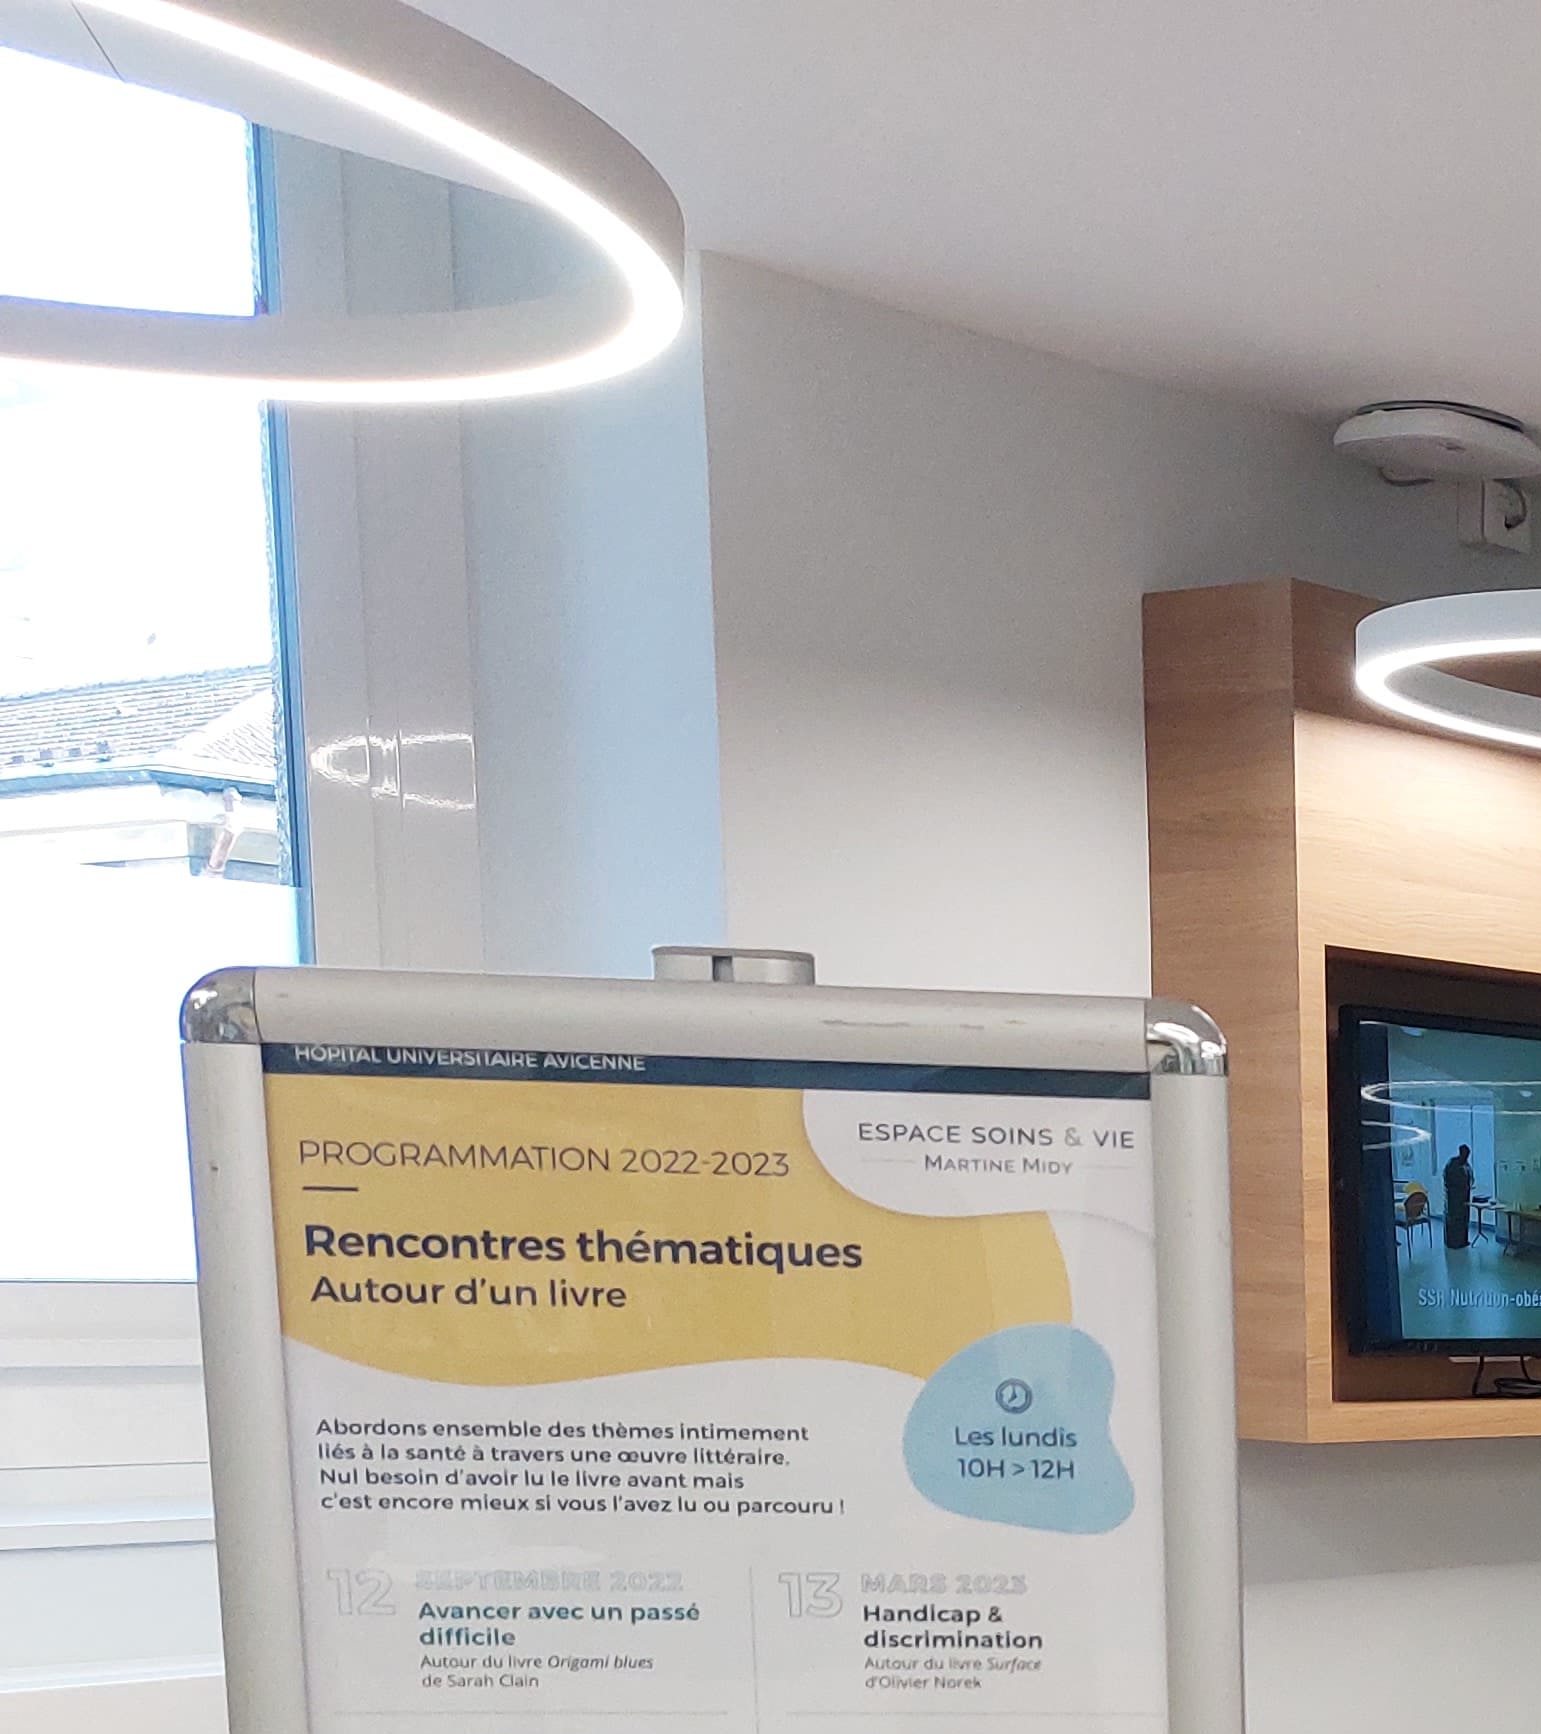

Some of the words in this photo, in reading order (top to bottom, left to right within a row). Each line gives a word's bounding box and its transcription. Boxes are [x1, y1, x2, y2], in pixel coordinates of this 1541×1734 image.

[544, 1052, 646, 1071] AVICENNE
[858, 1122, 960, 1143] ESPACE
[971, 1126, 1053, 1146] SOINS
[1064, 1127, 1083, 1147] &
[1093, 1130, 1134, 1149] VIE
[299, 1139, 611, 1171] PROGRAMMATION
[621, 1148, 790, 1178] 2022-2023
[304, 1224, 566, 1262] Rencontres
[576, 1228, 863, 1275] thématiques
[310, 1275, 445, 1304] Autour
[454, 1278, 537, 1307] d'un
[550, 1279, 627, 1308] livre
[315, 1418, 427, 1437] Abordons
[432, 1420, 542, 1438] ensemble
[547, 1422, 586, 1438] des
[592, 1422, 674, 1440] thèmes
[680, 1423, 810, 1442] intimement
[954, 1426, 995, 1447] Les
[1001, 1426, 1078, 1448] lundis
[318, 1442, 356, 1460] liés
[361, 1443, 375, 1461] à
[381, 1443, 399, 1460] la
[405, 1444, 466, 1462] santé
[472, 1445, 485, 1462] à
[491, 1446, 565, 1463] travers
[571, 1451, 612, 1464] une
[617, 1450, 688, 1465] œuvre
[693, 1447, 791, 1466] littéraire.
[320, 1468, 358, 1486] Nul
[365, 1468, 438, 1486] besoin
[445, 1469, 519, 1487] d'avoir
[525, 1470, 545, 1487] lu
[551, 1470, 570, 1487] le
[575, 1470, 622, 1488] livre
[627, 1474, 688, 1490] avant
[693, 1473, 745, 1490] mais
[957, 1457, 1005, 1479] 10H
[1030, 1458, 1075, 1480] 12H
[321, 1493, 373, 1510] c'est
[378, 1496, 455, 1511] encore
[460, 1494, 530, 1512] mieux
[535, 1494, 552, 1512] si
[557, 1498, 607, 1513] vous
[613, 1496, 673, 1513] l'avez
[677, 1496, 698, 1513] lu
[703, 1499, 731, 1514] ou
[737, 1499, 834, 1518] parcouru
[327, 1567, 397, 1617] 12
[778, 1571, 844, 1618] 13
[860, 1573, 948, 1595] MARS
[418, 1601, 521, 1621] Avancer
[527, 1603, 584, 1621] avec
[590, 1603, 623, 1621] un
[630, 1600, 700, 1625] passé
[863, 1605, 981, 1627] Handicap
[988, 1605, 1004, 1623] &
[418, 1626, 517, 1646] difficile
[863, 1629, 1044, 1650] discrimination
[420, 1654, 477, 1670] Autour
[482, 1654, 503, 1670] du
[508, 1654, 543, 1670] livre
[547, 1654, 610, 1673] Origami
[614, 1654, 655, 1671] blues
[864, 1656, 918, 1671] Autour
[923, 1656, 945, 1671] du
[949, 1656, 983, 1671] livre
[987, 1656, 1043, 1673] Surface
[422, 1673, 443, 1688] de
[448, 1673, 494, 1688] Sarah
[499, 1673, 540, 1689] Clain
[865, 1675, 929, 1689] d'Olivier
[933, 1675, 983, 1690] Norek
